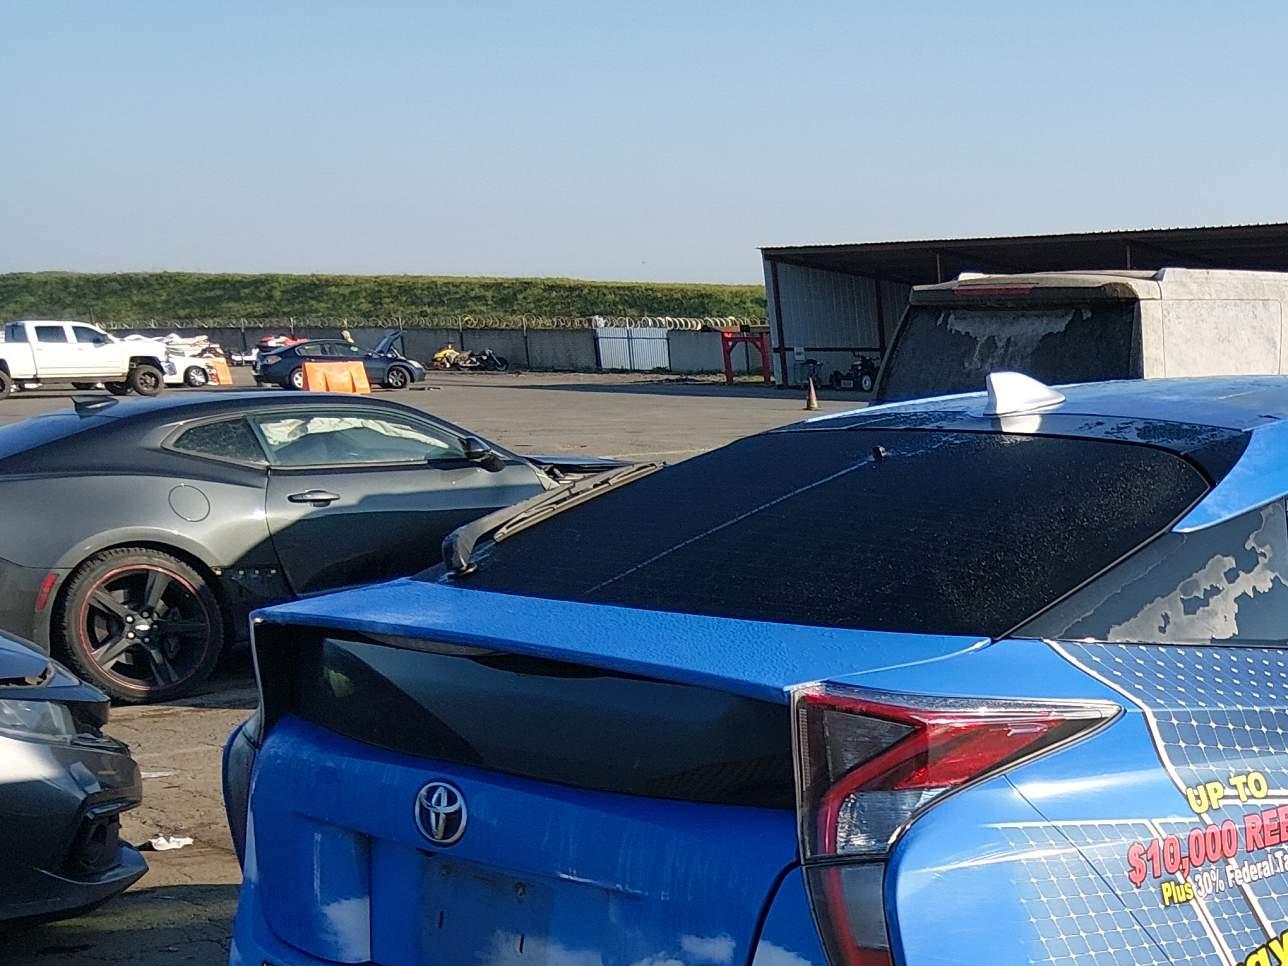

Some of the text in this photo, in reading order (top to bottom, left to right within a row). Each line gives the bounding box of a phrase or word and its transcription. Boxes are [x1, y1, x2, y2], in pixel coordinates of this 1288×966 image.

[1186, 772, 1268, 813] UP TO
[1128, 819, 1238, 888] $10,000
[1161, 879, 1193, 905] Plus
[1194, 869, 1224, 897] 30%
[1226, 854, 1275, 887] Federal
